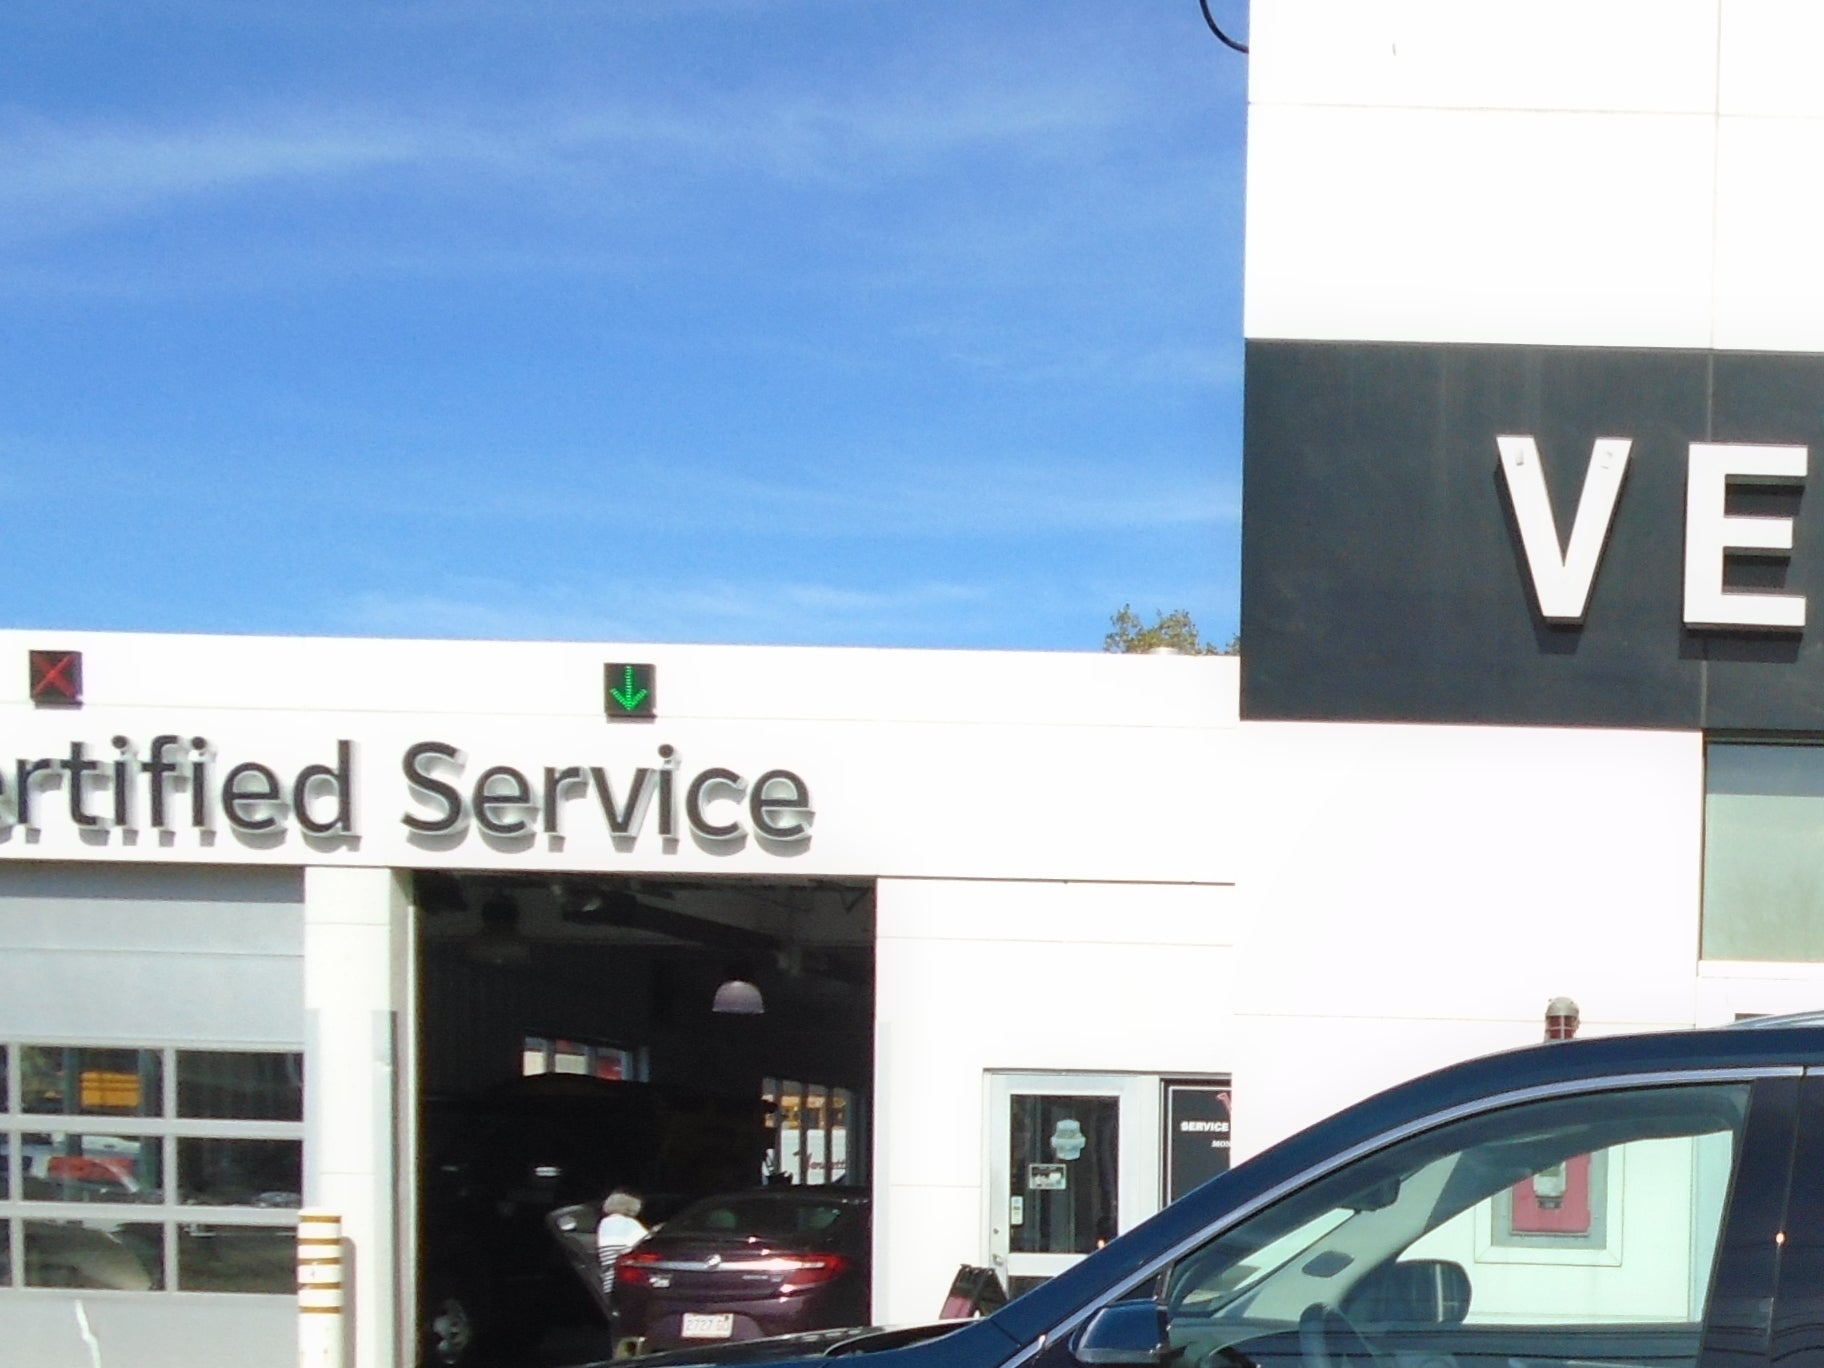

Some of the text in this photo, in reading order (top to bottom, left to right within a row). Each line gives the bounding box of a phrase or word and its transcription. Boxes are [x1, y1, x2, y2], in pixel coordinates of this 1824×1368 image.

[0, 735, 812, 840] rtified Service
[1180, 1121, 1229, 1132] SERVICE
